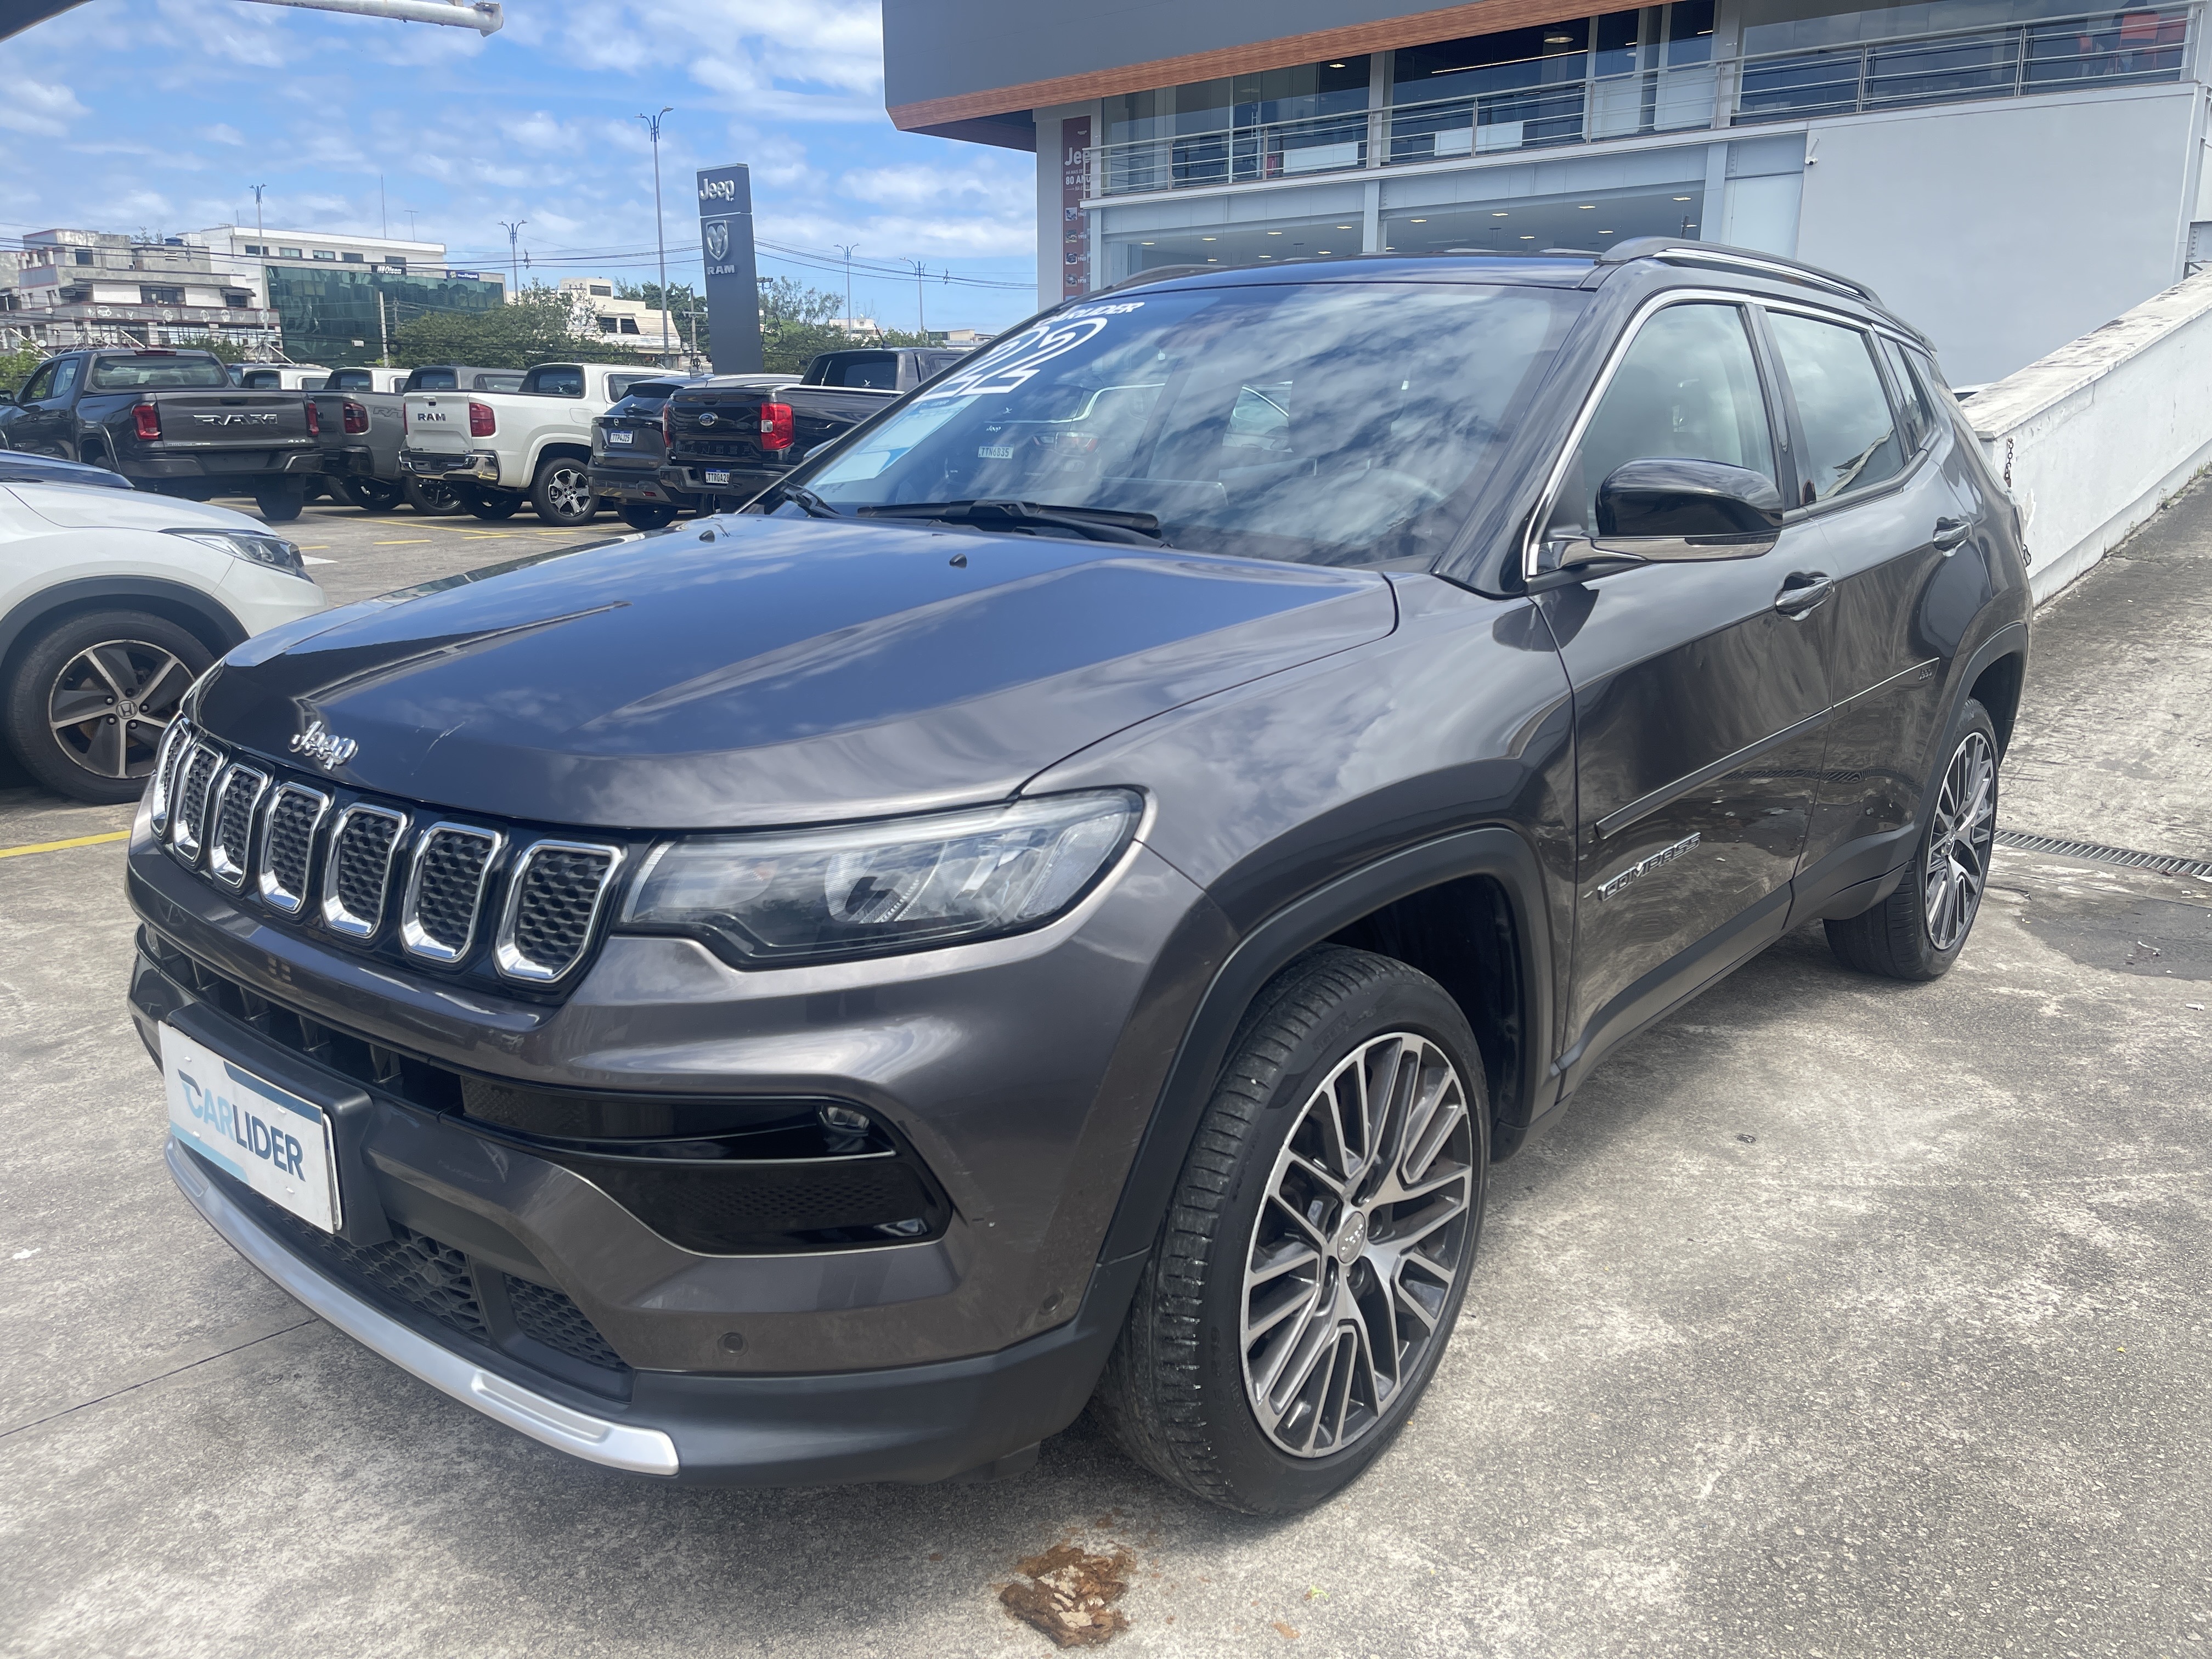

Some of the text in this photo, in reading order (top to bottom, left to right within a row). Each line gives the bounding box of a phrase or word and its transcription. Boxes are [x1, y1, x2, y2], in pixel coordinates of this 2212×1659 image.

[1064, 147, 1091, 166] Jee
[1065, 176, 1074, 185] 80
[699, 178, 735, 201] Jeep
[707, 264, 735, 275] RAM
[193, 414, 278, 426] RAM
[417, 413, 446, 421] RAM
[981, 448, 1009, 458] TTN6B35
[288, 720, 359, 771] Jeep
[1597, 831, 1701, 901] COMPASS
[177, 1068, 306, 1182] CARLIDER
